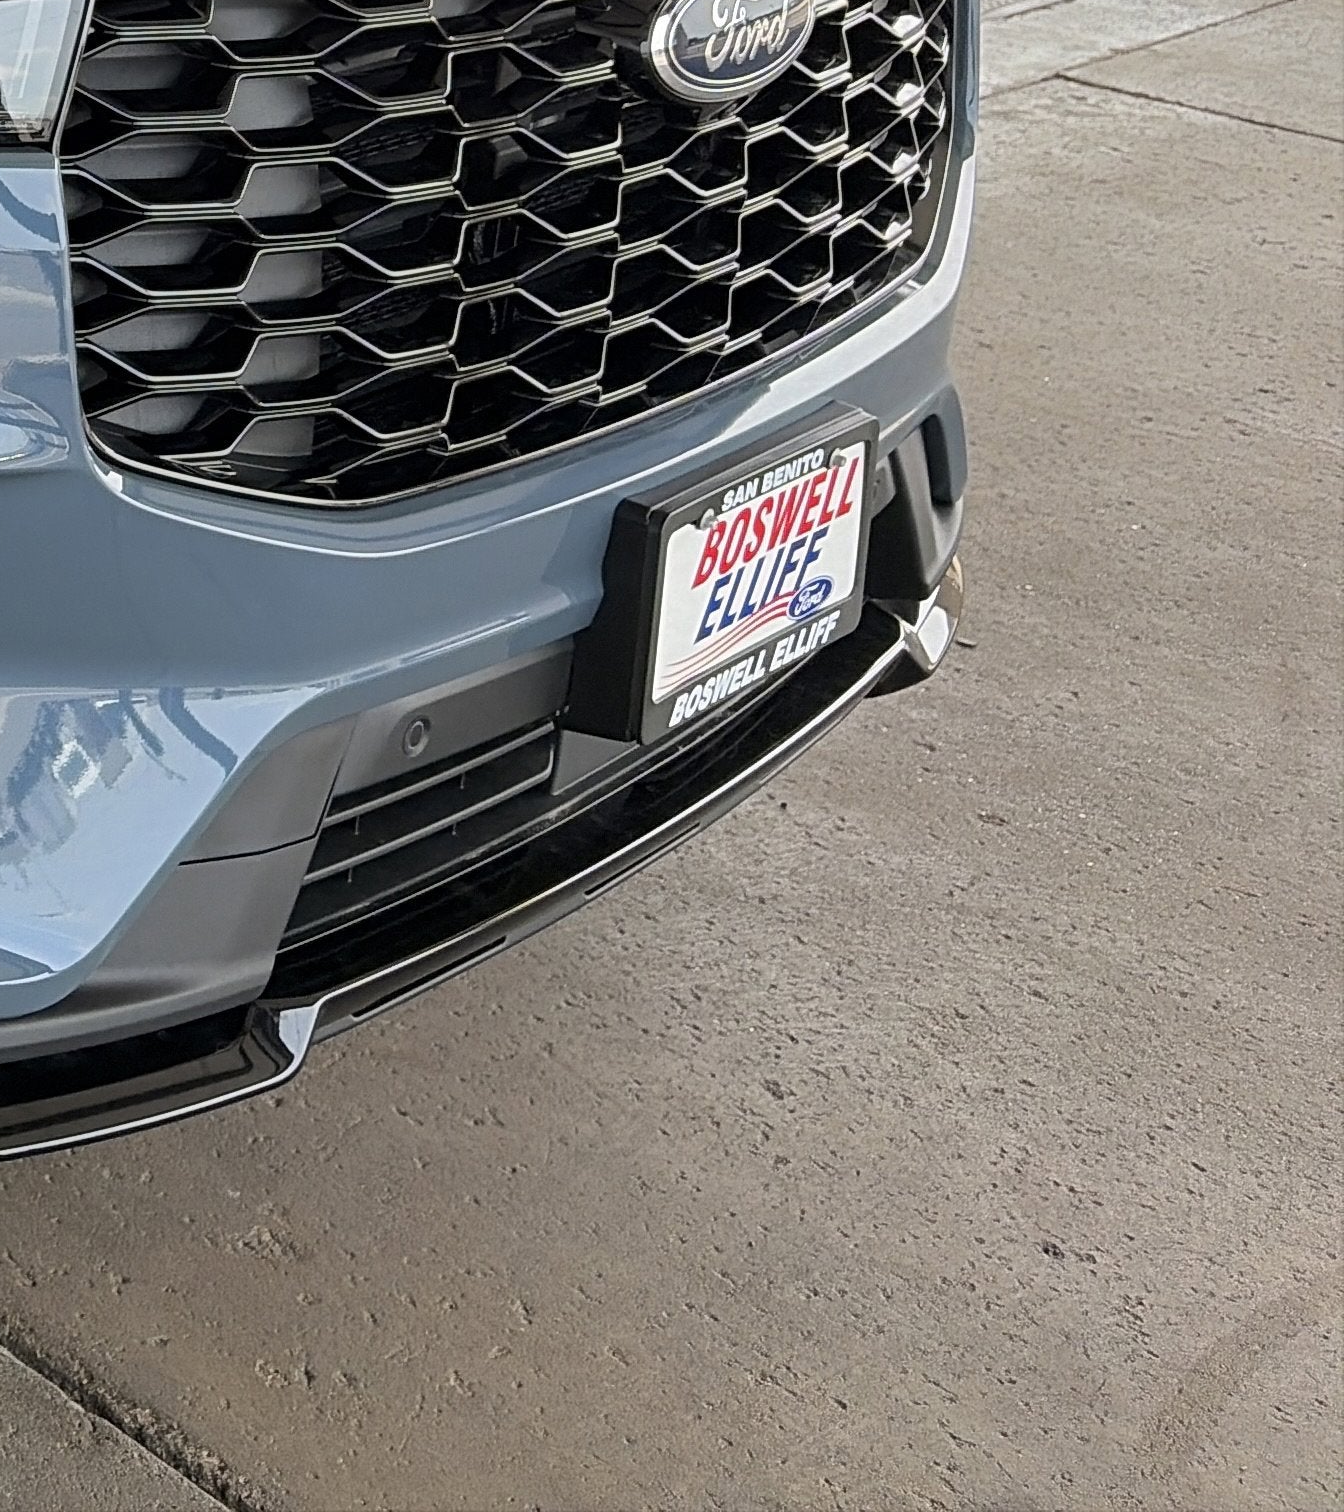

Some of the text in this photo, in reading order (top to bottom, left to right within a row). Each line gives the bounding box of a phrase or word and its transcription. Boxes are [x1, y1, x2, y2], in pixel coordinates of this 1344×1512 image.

[691, 456, 860, 590] BOSWELL
[720, 448, 825, 513] SAN BENITO
[694, 528, 829, 644] ELLIFF
[793, 583, 832, 616] Ford
[668, 610, 840, 729] BOSWELL ELLIFF
